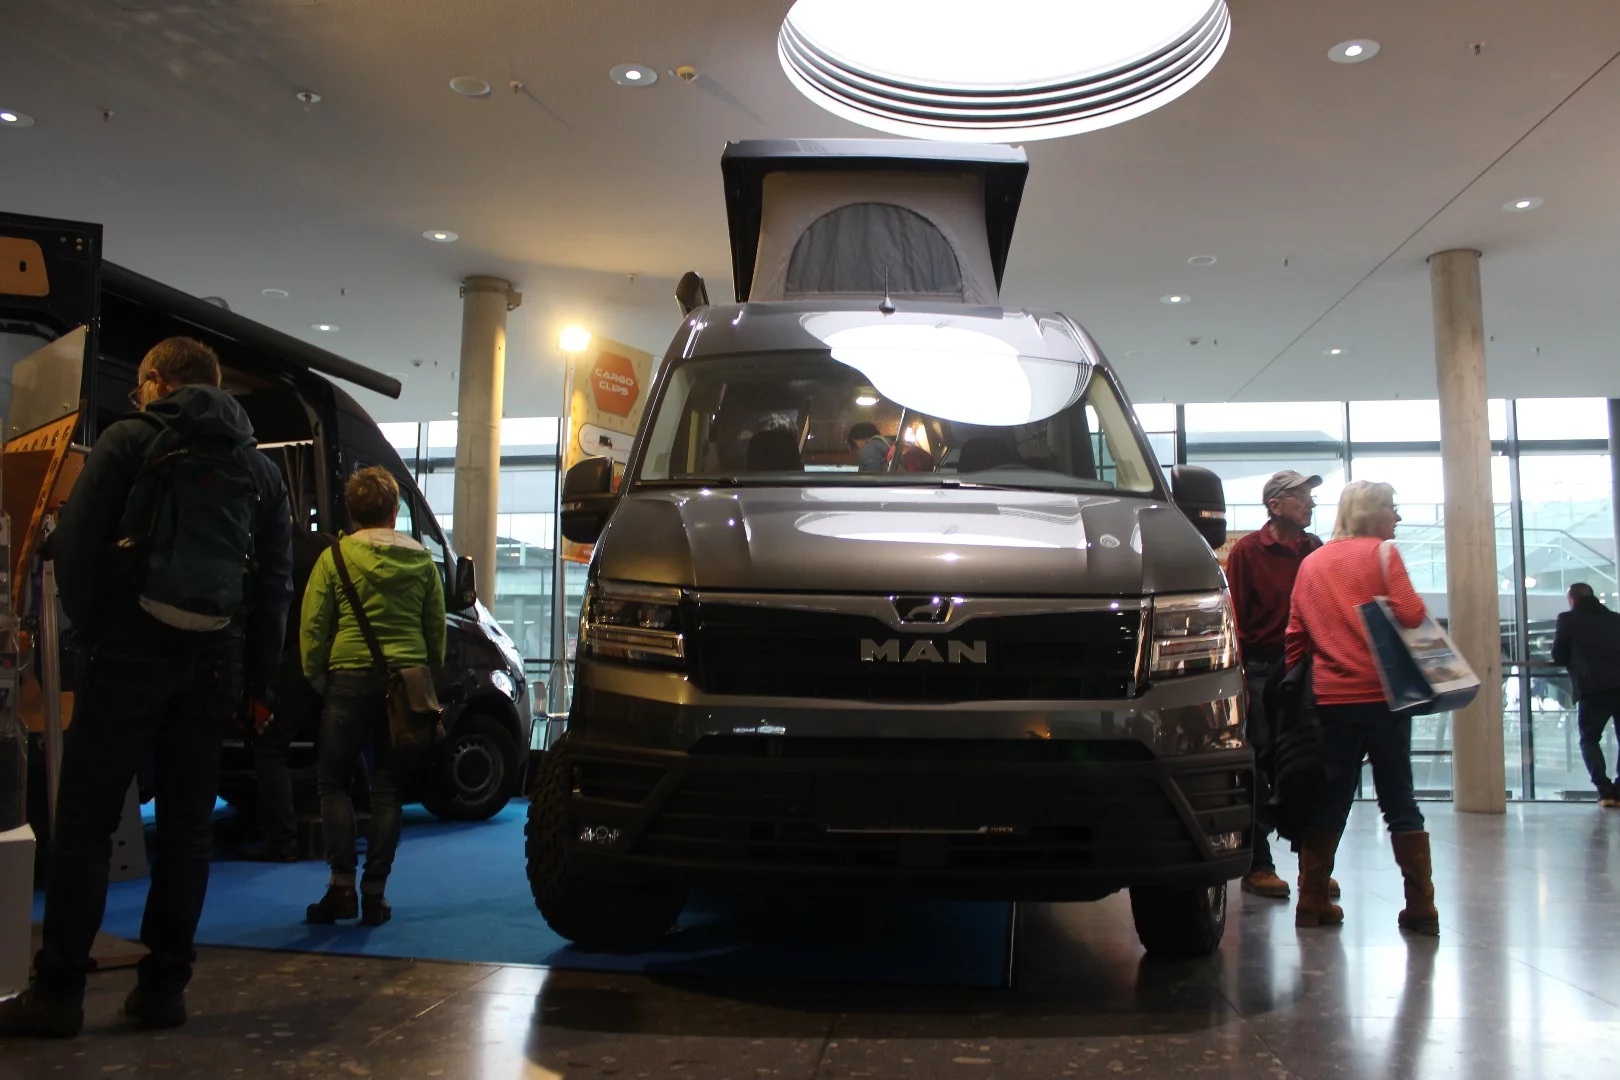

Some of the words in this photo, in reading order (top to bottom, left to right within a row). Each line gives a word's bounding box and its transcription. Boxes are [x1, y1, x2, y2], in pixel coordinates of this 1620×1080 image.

[595, 368, 634, 387] CARGO
[599, 380, 629, 396] CLIPS
[860, 638, 987, 664] MAN
